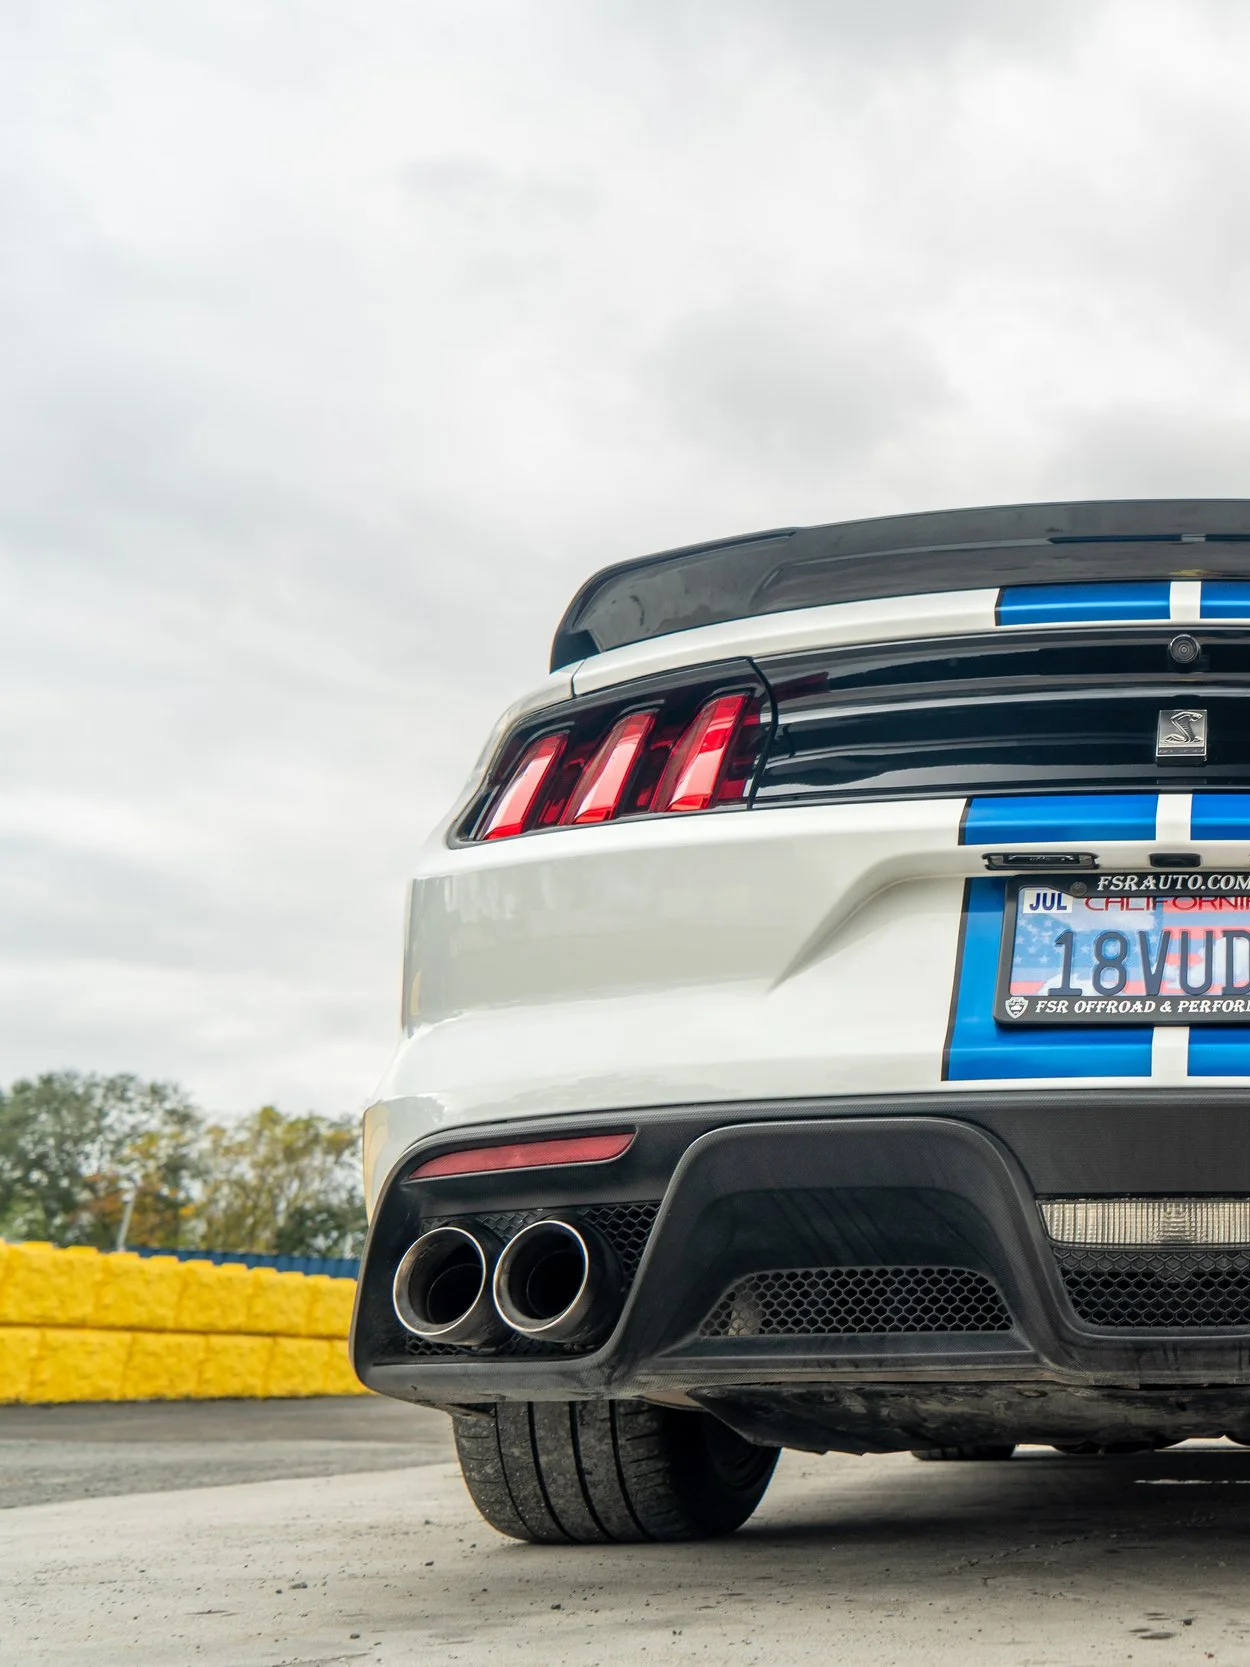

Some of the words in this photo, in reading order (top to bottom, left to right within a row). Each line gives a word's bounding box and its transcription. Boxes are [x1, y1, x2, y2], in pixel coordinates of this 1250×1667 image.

[1029, 891, 1067, 911] JUL
[1035, 1000, 1069, 1014] FSR
[1073, 1000, 1156, 1014] OFFROAD
[1159, 1001, 1173, 1013] &
